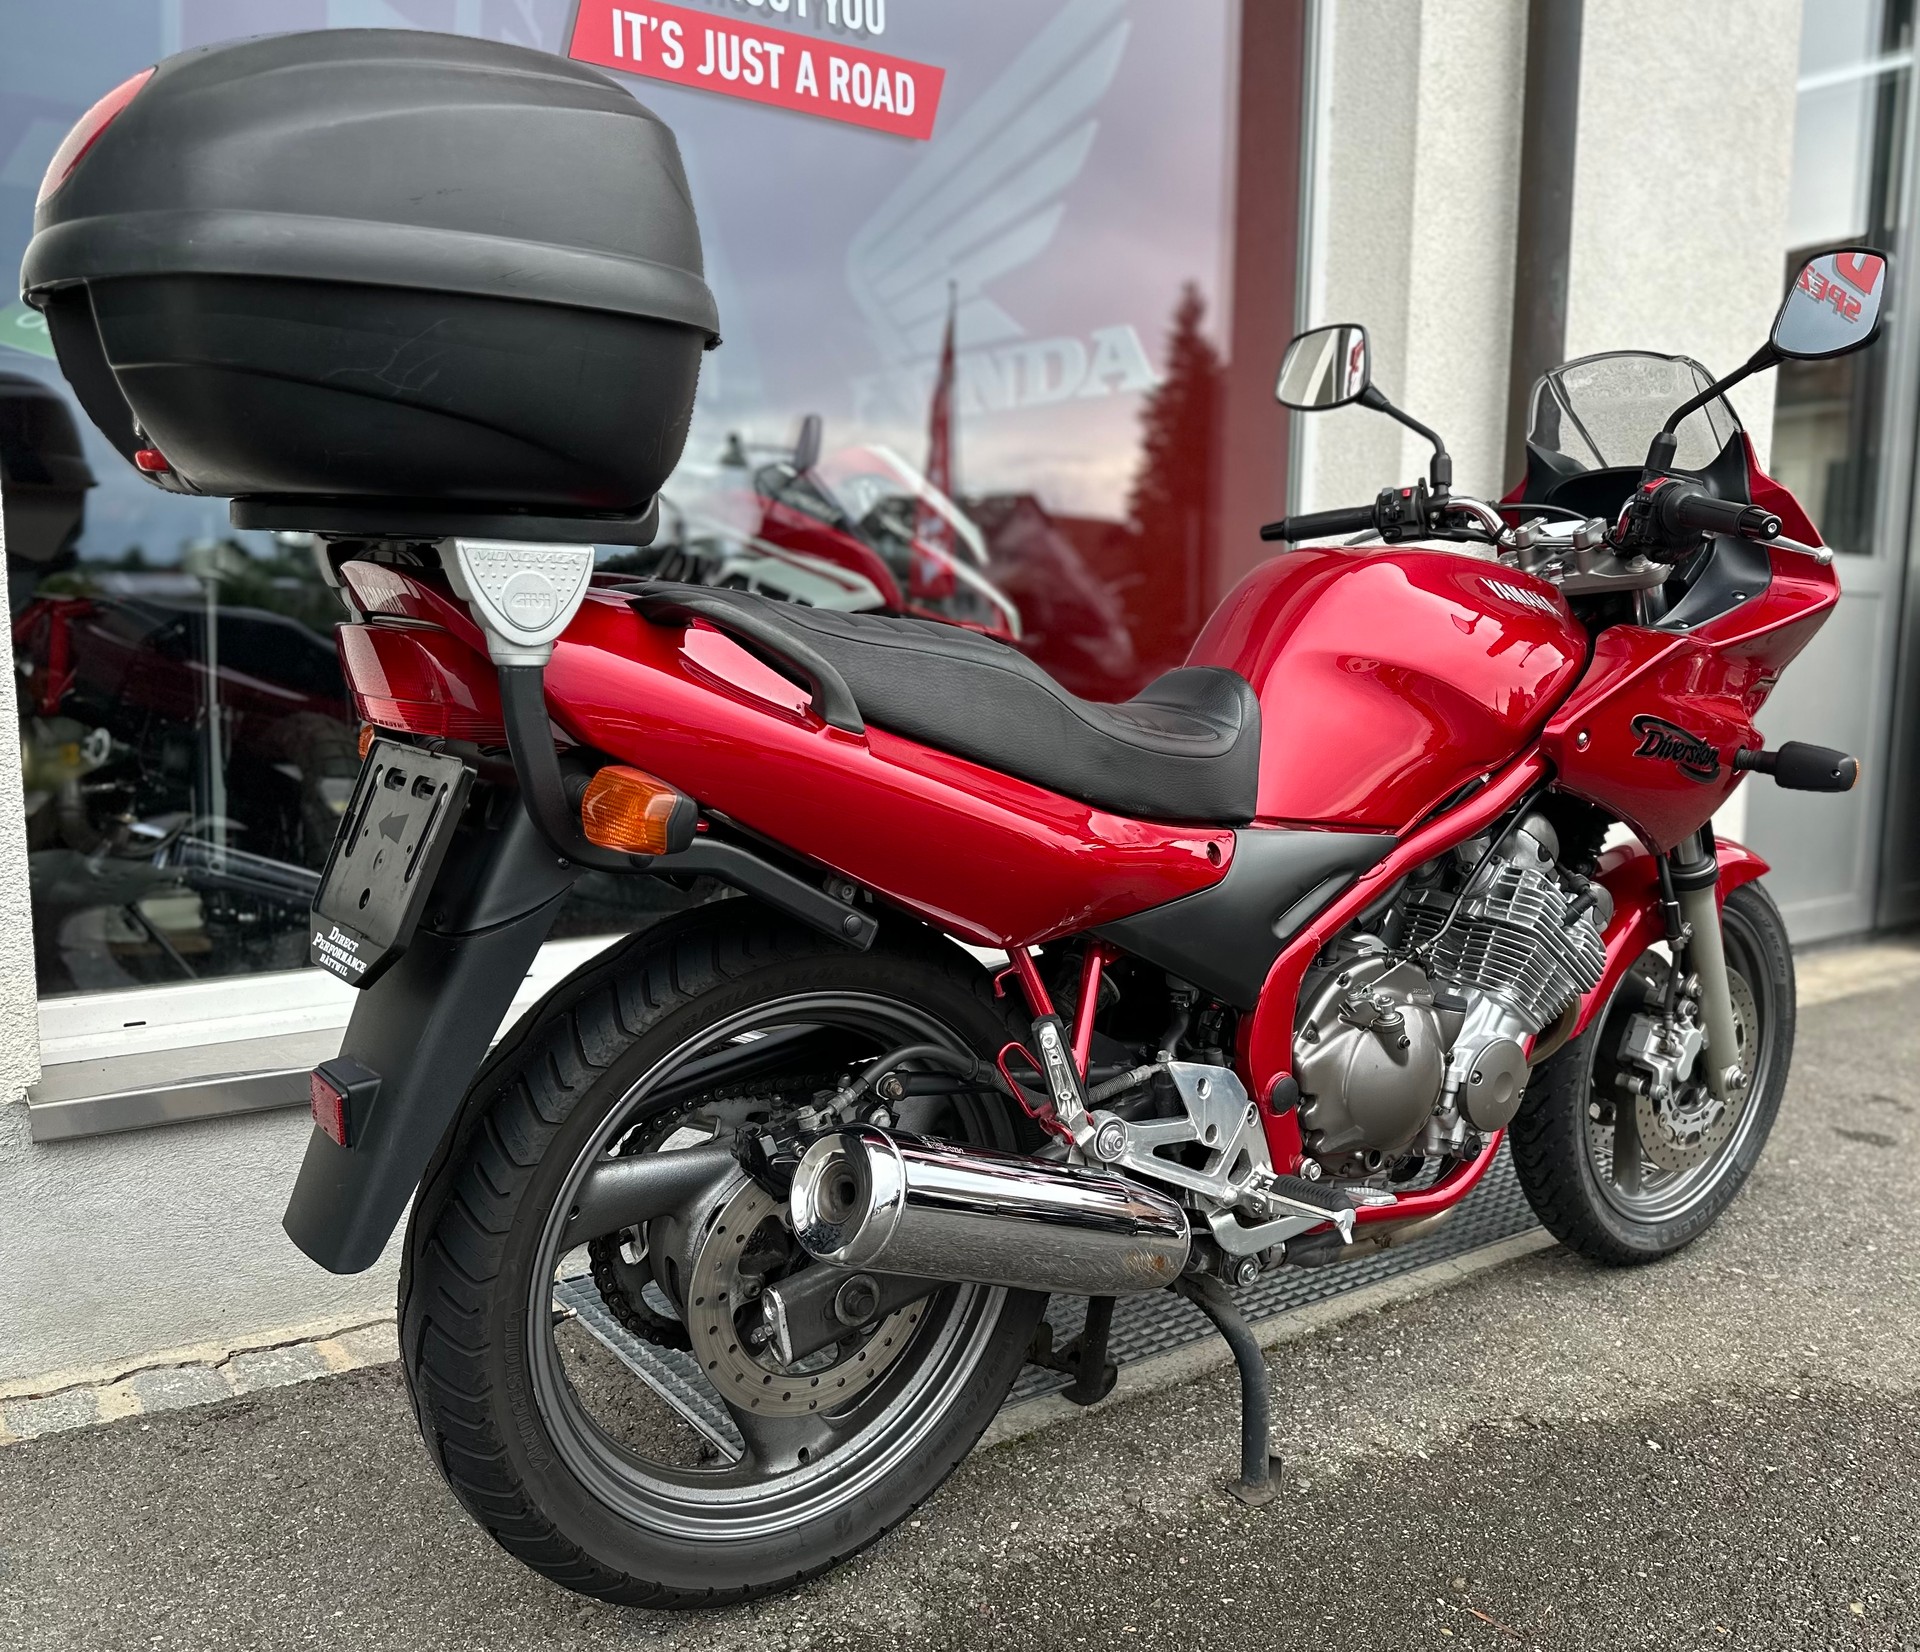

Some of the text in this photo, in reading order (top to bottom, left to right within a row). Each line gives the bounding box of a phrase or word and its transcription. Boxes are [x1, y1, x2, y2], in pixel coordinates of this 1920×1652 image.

[612, 9, 915, 117] IT'S JUST A ROAD
[852, 325, 1160, 424] NDA
[475, 551, 580, 565] MONORACK
[355, 584, 408, 614] YAMAHA
[511, 592, 551, 609] GIVI
[1479, 576, 1563, 617] YAMAHA
[1631, 728, 1720, 769] Diversion
[312, 932, 367, 974] PERFORMANCE
[328, 926, 359, 953] DIRECT
[1673, 1169, 1742, 1238] METZELER
[504, 1319, 549, 1468] BRIDGESTONE
